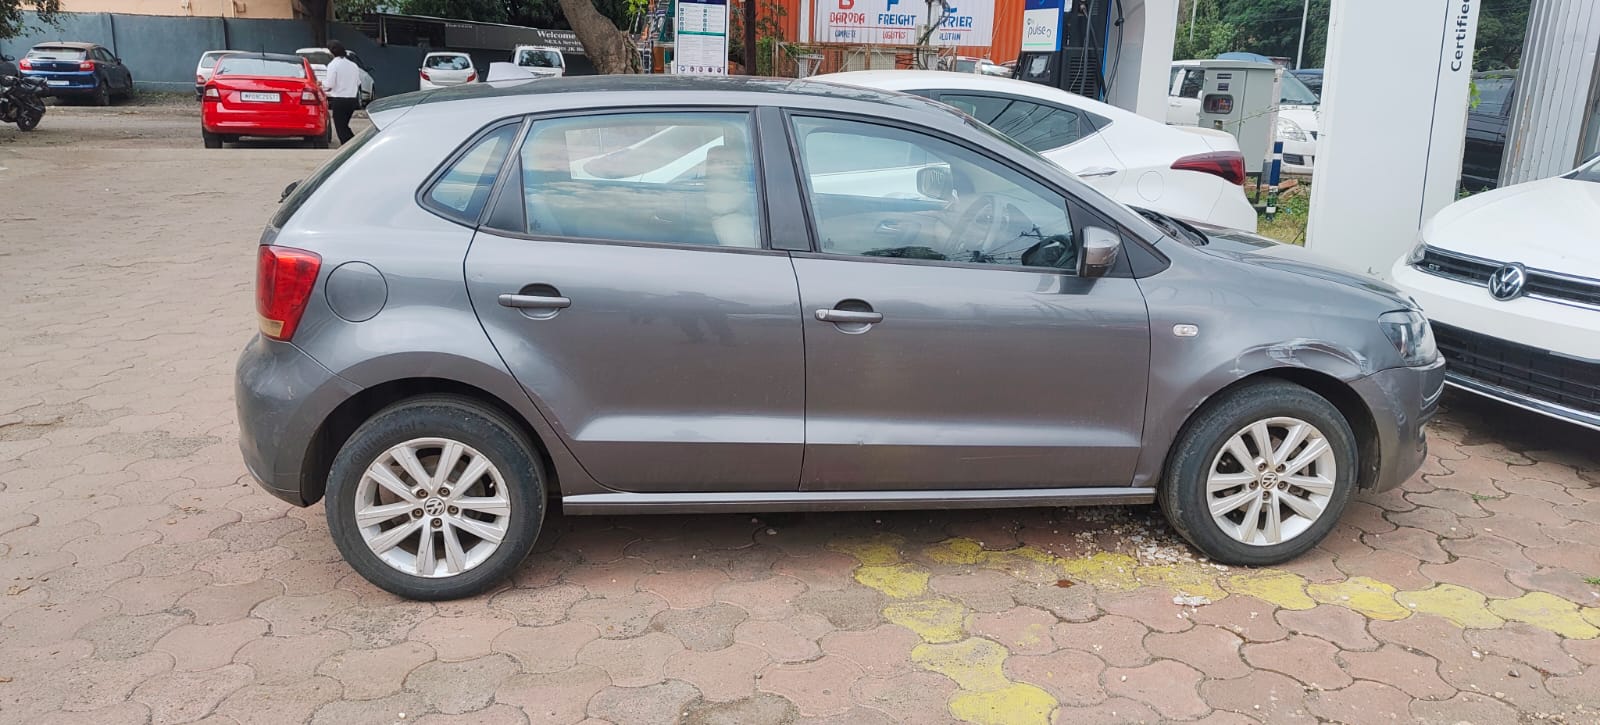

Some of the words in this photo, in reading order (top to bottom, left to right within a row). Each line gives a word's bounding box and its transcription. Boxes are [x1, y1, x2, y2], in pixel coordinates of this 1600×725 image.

[830, 12, 865, 24] BARODA
[878, 14, 916, 26] FREIGHT
[940, 16, 973, 28] RRIER
[537, 30, 576, 39] Welcome
[1451, 0, 1470, 71] Certifie
